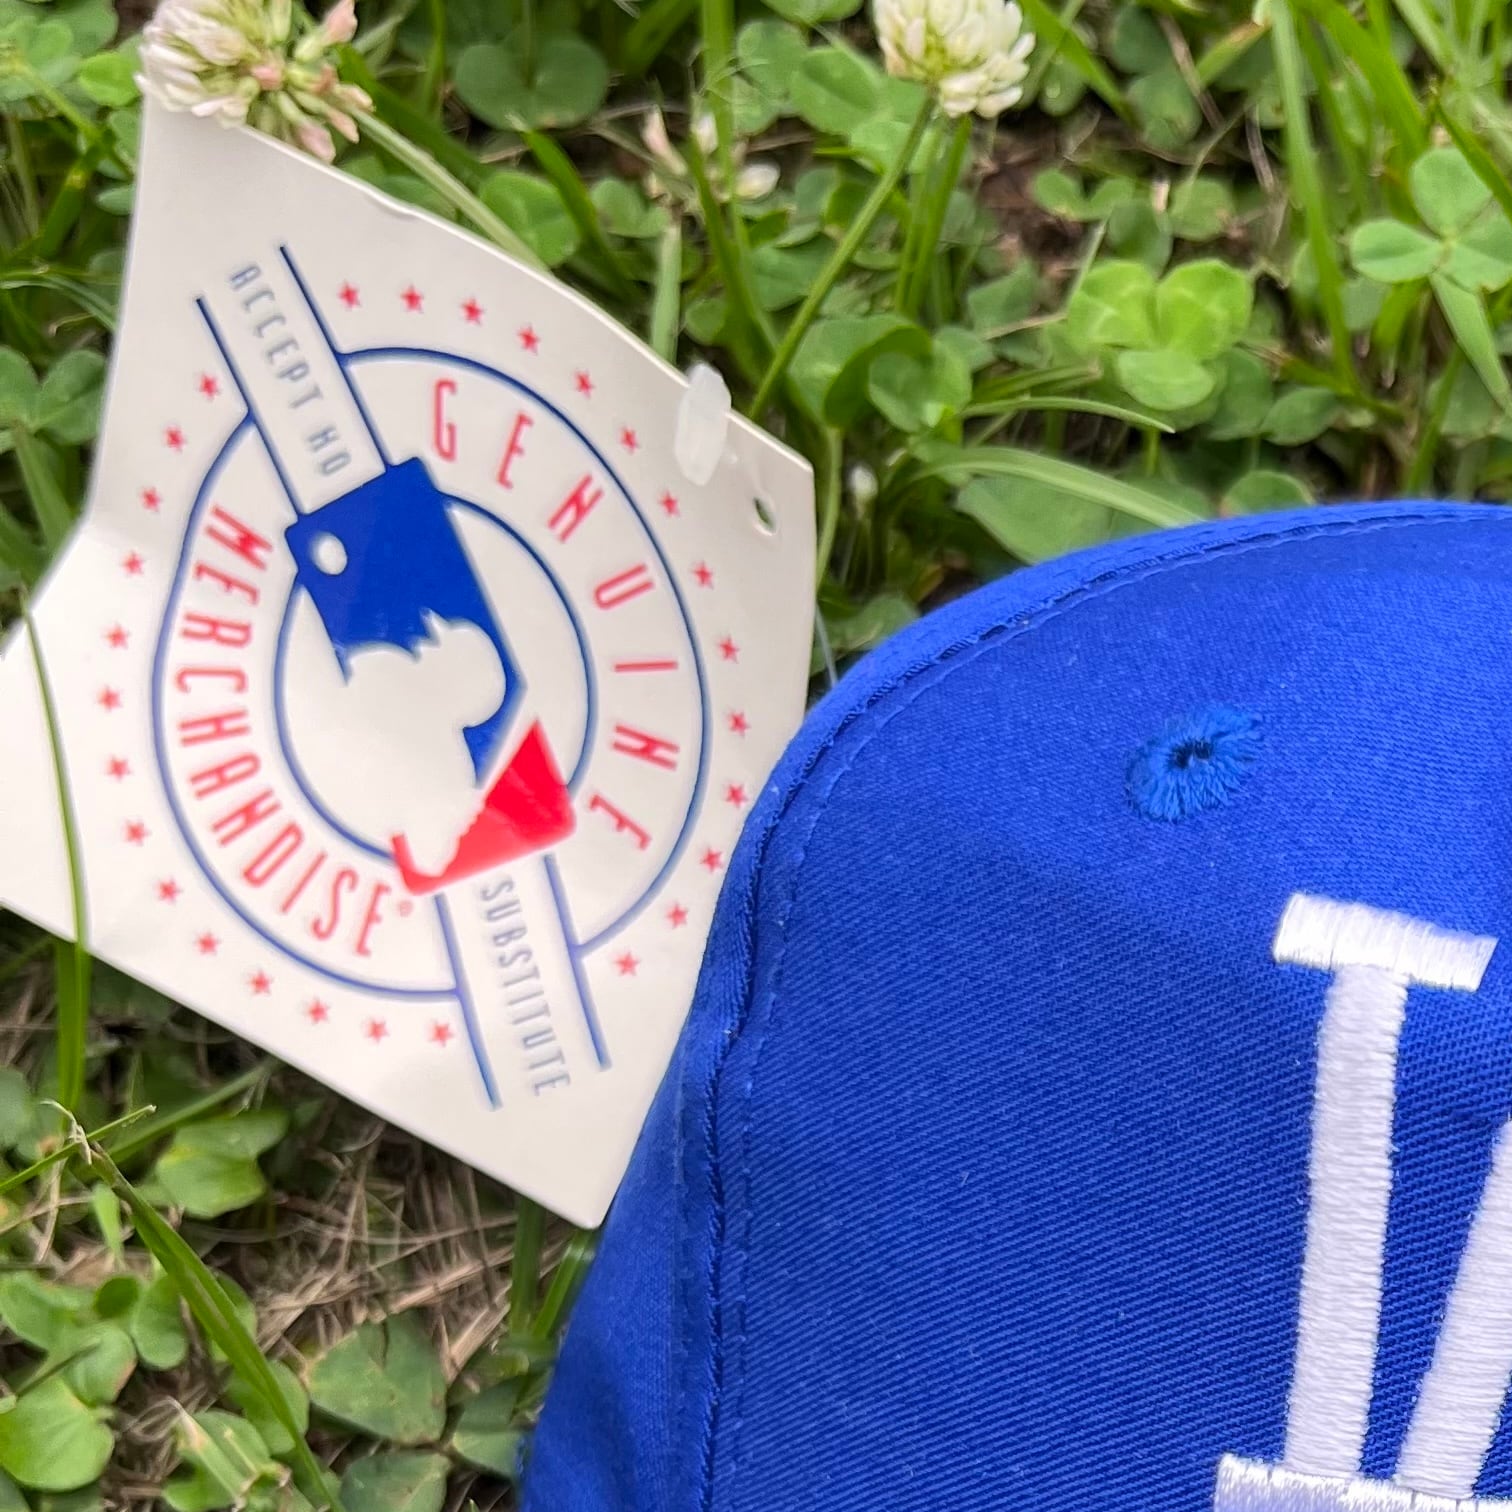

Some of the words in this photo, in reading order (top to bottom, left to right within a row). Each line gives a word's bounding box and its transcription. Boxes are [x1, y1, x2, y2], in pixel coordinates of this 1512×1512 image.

[229, 263, 324, 409] ACCEPT
[307, 424, 351, 476] NO
[432, 377, 681, 851] GENUINE
[480, 874, 572, 1097] SUBSTITUTE
